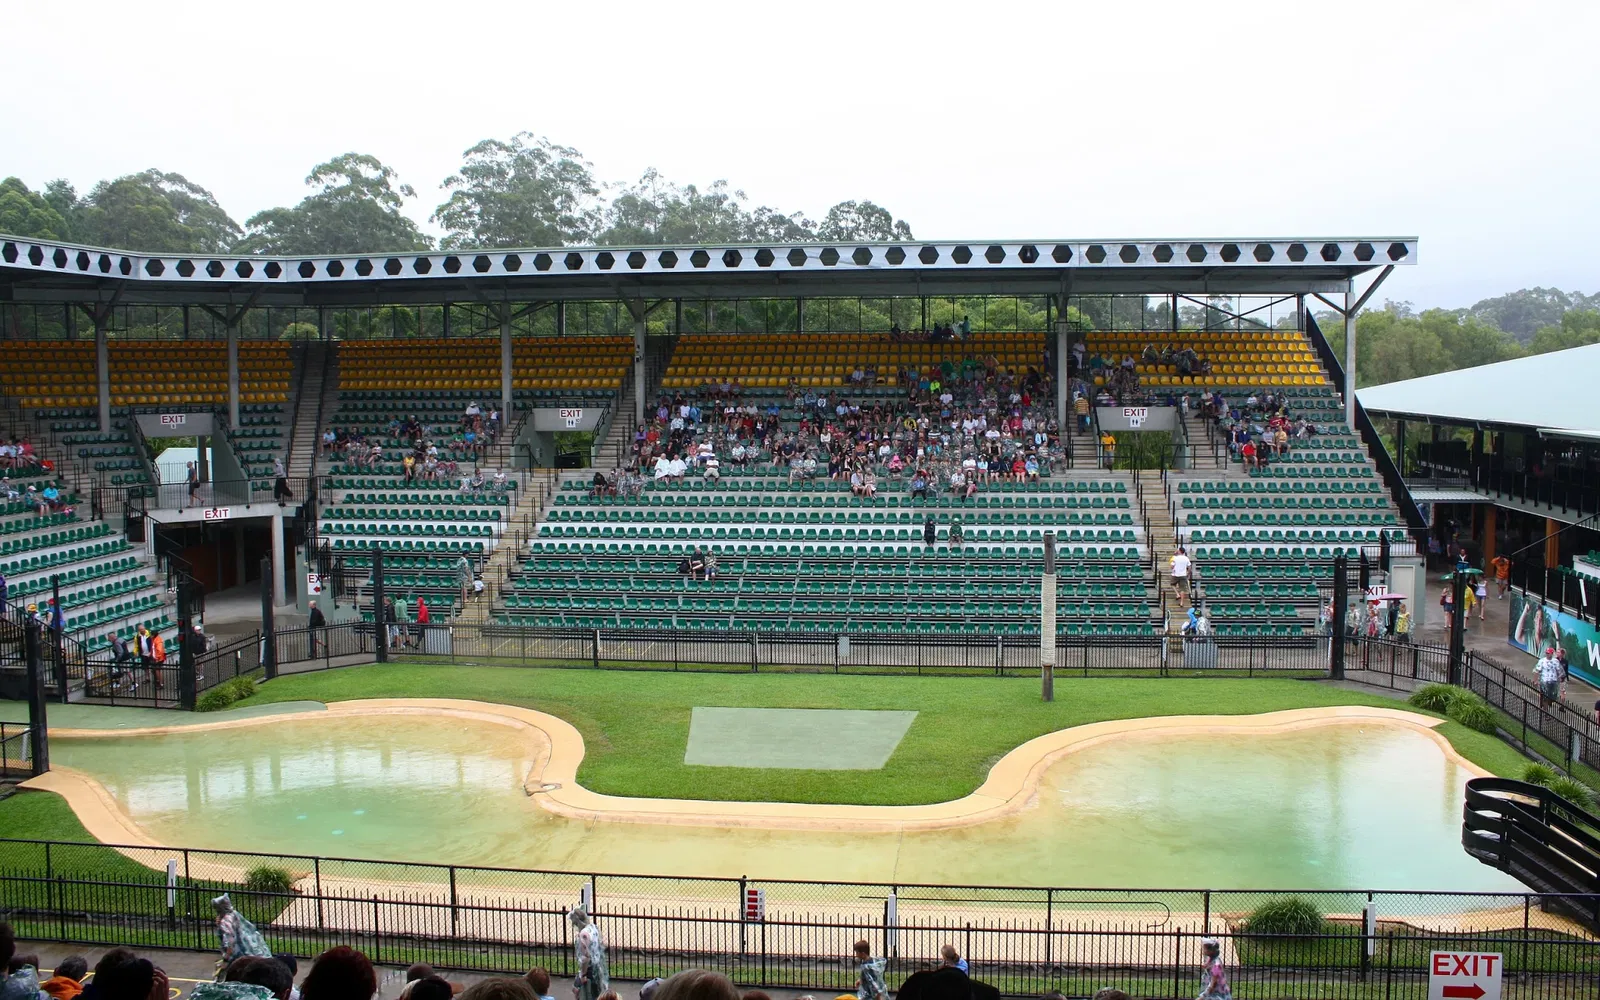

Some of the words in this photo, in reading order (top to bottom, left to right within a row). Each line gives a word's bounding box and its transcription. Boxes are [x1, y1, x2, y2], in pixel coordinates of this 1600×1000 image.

[560, 409, 581, 418] EXIT
[1124, 408, 1146, 417] EXIT
[161, 415, 184, 424] EXIT
[204, 509, 229, 519] EXIT
[1366, 586, 1387, 596] XIT
[1433, 954, 1499, 977] EXIT
